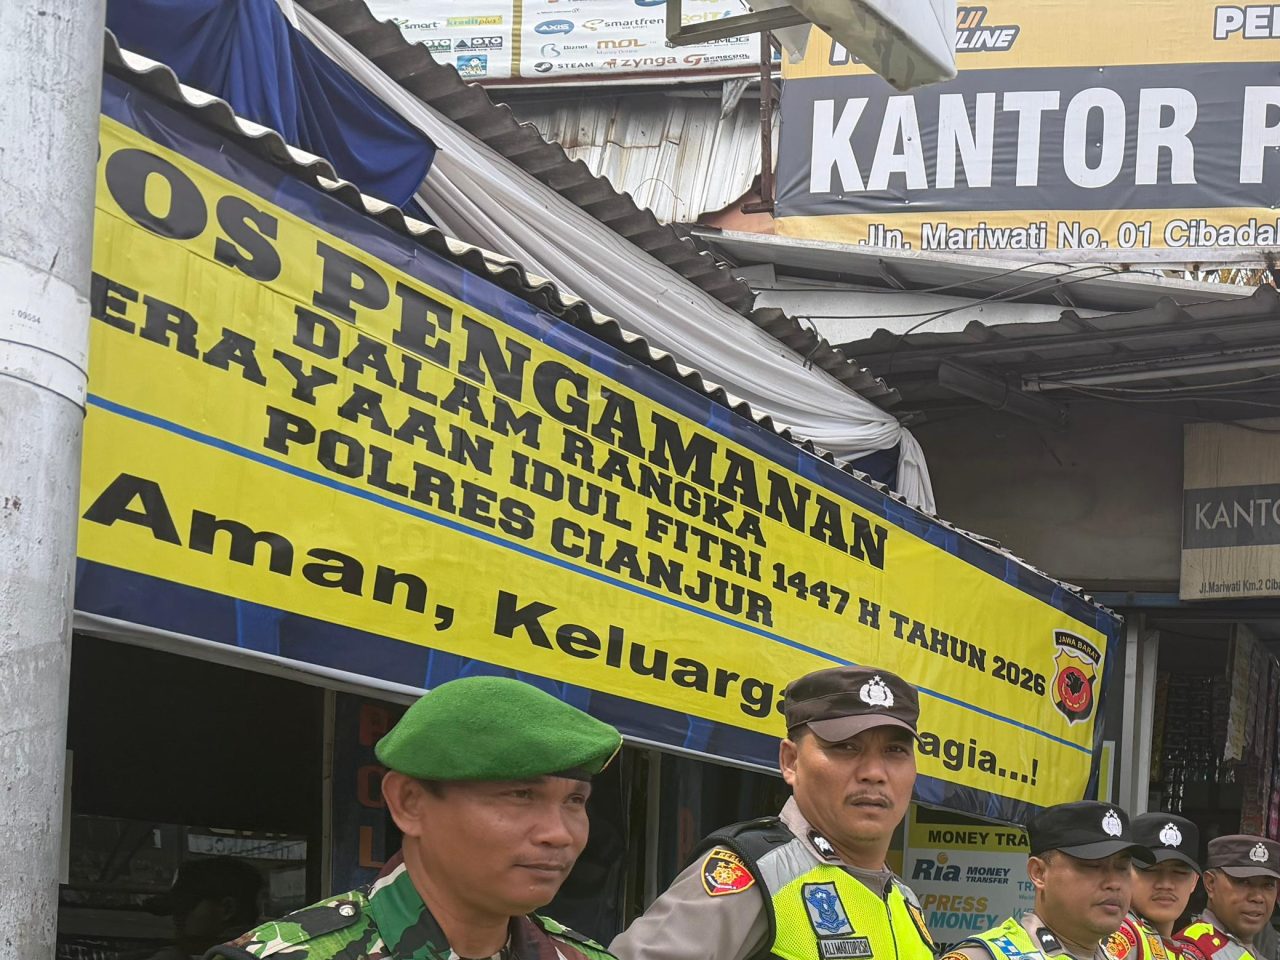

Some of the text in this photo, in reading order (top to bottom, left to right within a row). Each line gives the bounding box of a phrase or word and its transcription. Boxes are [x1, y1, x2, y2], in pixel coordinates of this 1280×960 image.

[604, 18, 664, 27] smartfren
[956, 29, 1016, 49] LINE
[621, 56, 677, 67] zynga
[809, 87, 1198, 194] KANTOR
[859, 224, 911, 249] Jln.
[921, 222, 1047, 250] Mariwati
[1057, 221, 1109, 249] No.
[1118, 219, 1152, 248] 01
[98, 144, 888, 571] OS PENGAMANAN
[293, 304, 767, 548] DALAM RANGKA
[263, 404, 775, 628] POLRES CIANJUR
[509, 449, 635, 532] IDUL
[645, 511, 763, 583] FITRI
[772, 563, 850, 615] 1447
[858, 596, 882, 631] H
[889, 609, 987, 673] TAHUN
[992, 655, 1047, 698] 2026
[1243, 578, 1264, 592] Km.2
[82, 472, 456, 632] Aman,
[918, 729, 1041, 787] agia...!
[1058, 635, 1099, 661] JAWA BARAT
[928, 830, 989, 844] MONEY
[912, 852, 1010, 881] Ria MONEY
[966, 876, 1009, 885] TRANSFER
[929, 912, 998, 930] MONEY
